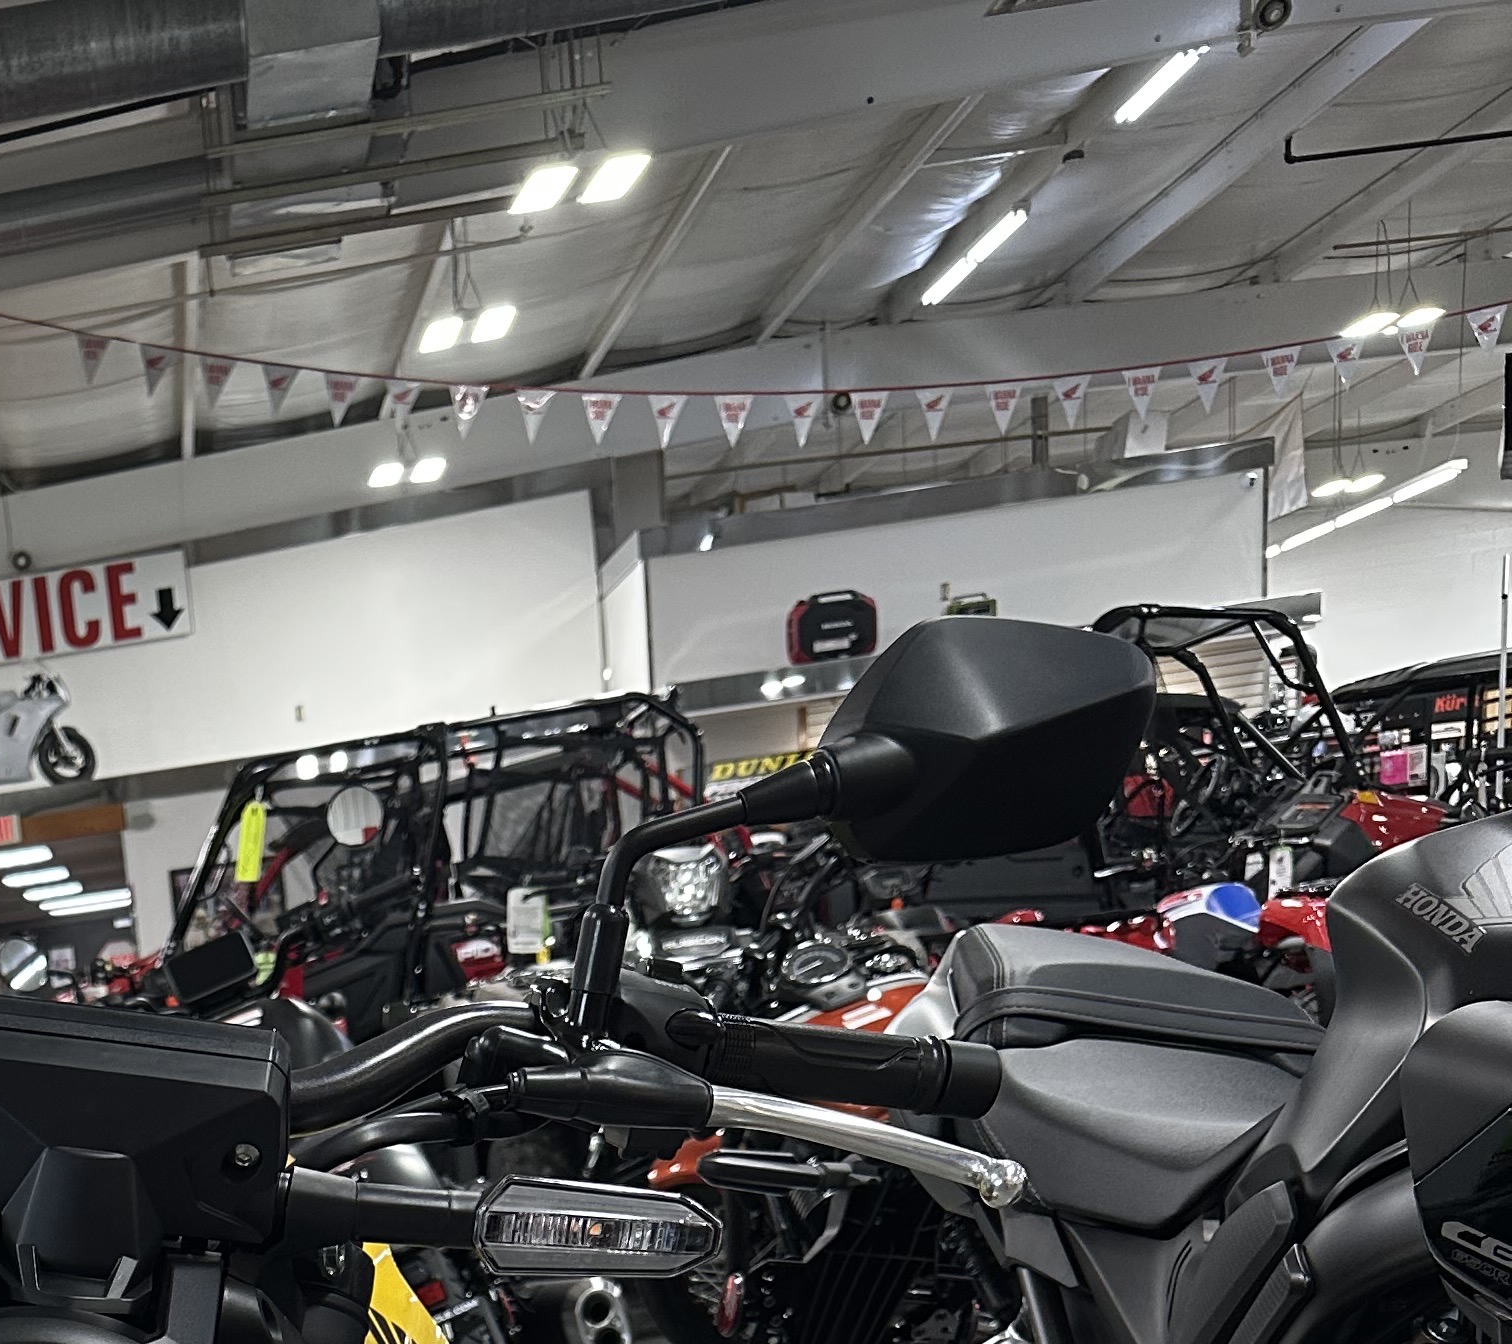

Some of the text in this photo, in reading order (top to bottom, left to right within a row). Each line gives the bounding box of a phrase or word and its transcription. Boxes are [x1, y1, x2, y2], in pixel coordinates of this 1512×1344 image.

[1434, 693, 1468, 713] Kür
[709, 750, 816, 781] DUNL
[1395, 882, 1486, 955] HONDA
